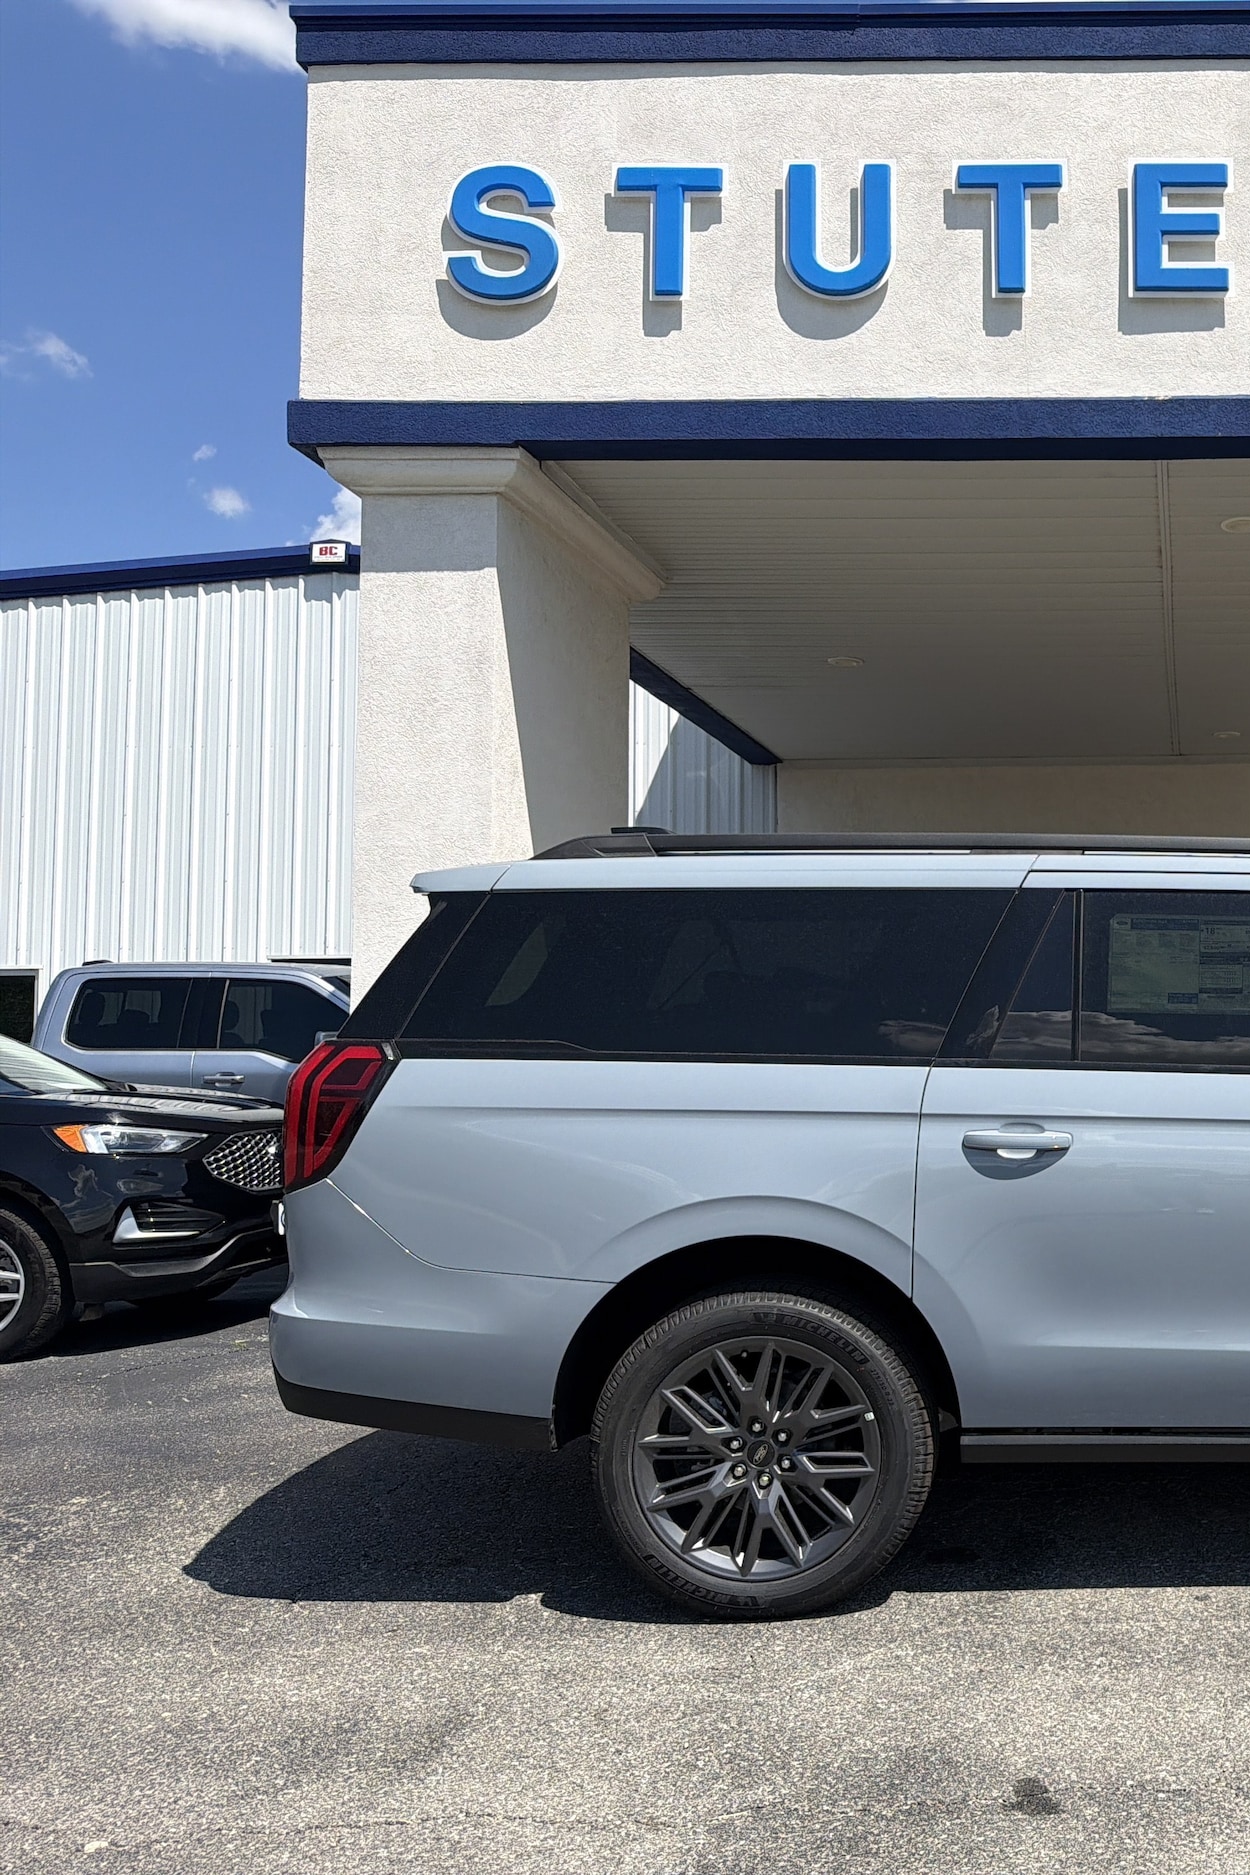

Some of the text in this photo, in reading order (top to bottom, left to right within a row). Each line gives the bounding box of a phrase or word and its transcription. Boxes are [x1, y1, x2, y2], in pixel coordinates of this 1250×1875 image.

[319, 546, 338, 556] BC
[782, 1315, 867, 1363] MICHELIN
[646, 1555, 729, 1605] MICHELIN
